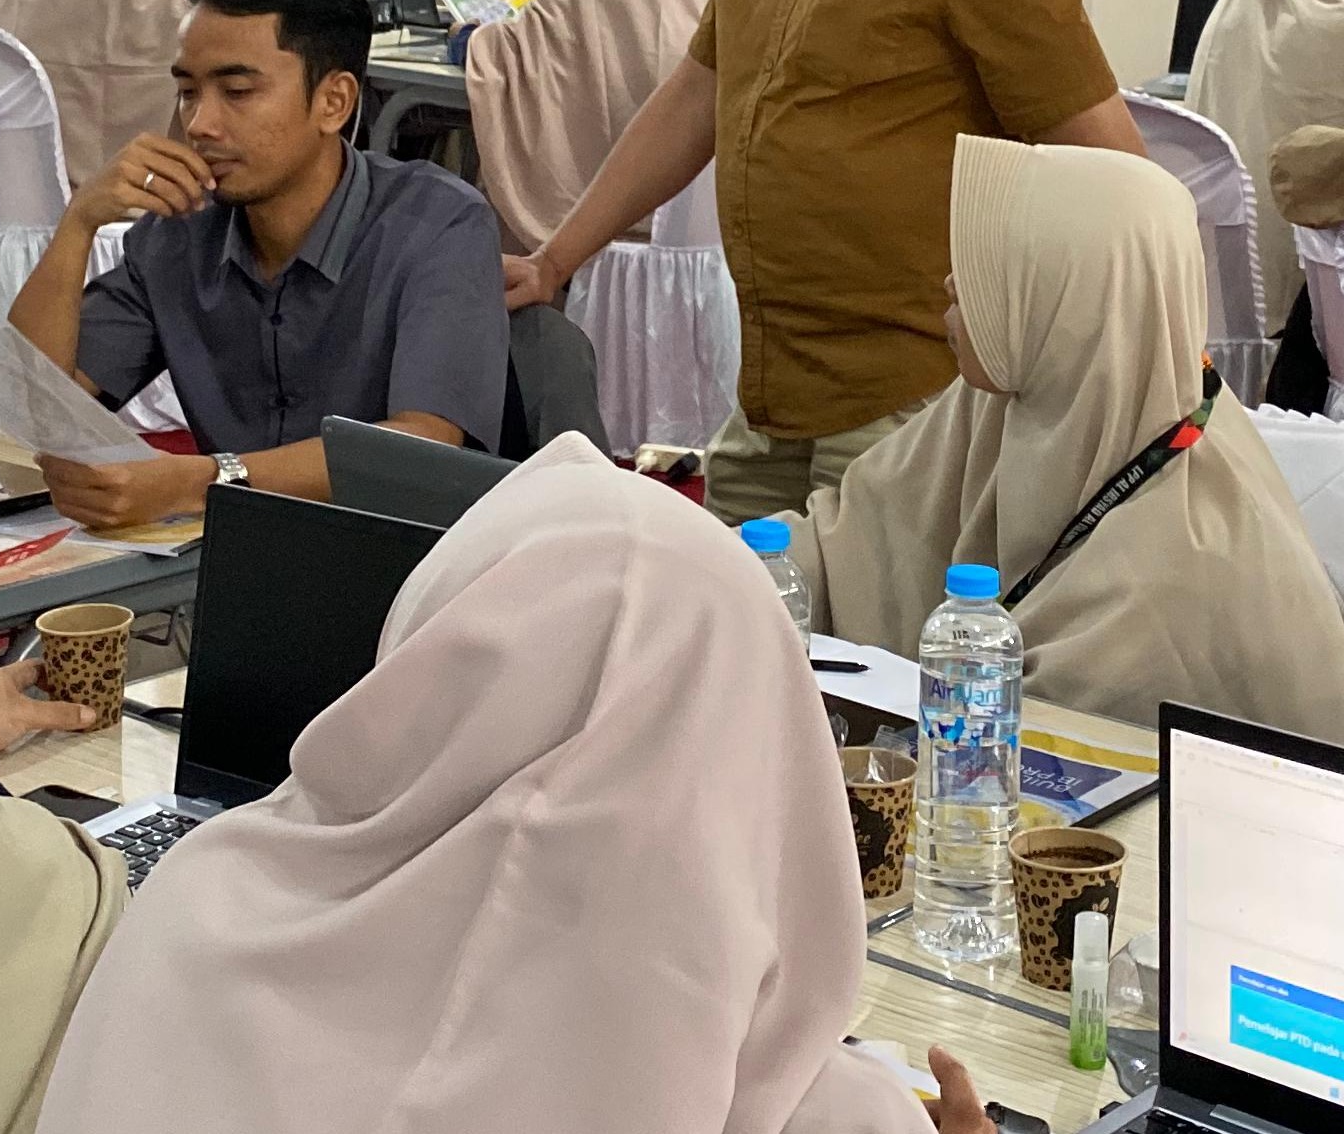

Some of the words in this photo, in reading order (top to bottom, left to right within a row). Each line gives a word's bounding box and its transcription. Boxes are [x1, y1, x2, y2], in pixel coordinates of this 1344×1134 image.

[1127, 465, 1144, 484] LPP
[1116, 477, 1130, 493] AL
[1023, 775, 1071, 793] BUIL
[1238, 1014, 1288, 1040] Pemelajar
[1312, 1042, 1340, 1058] pada
